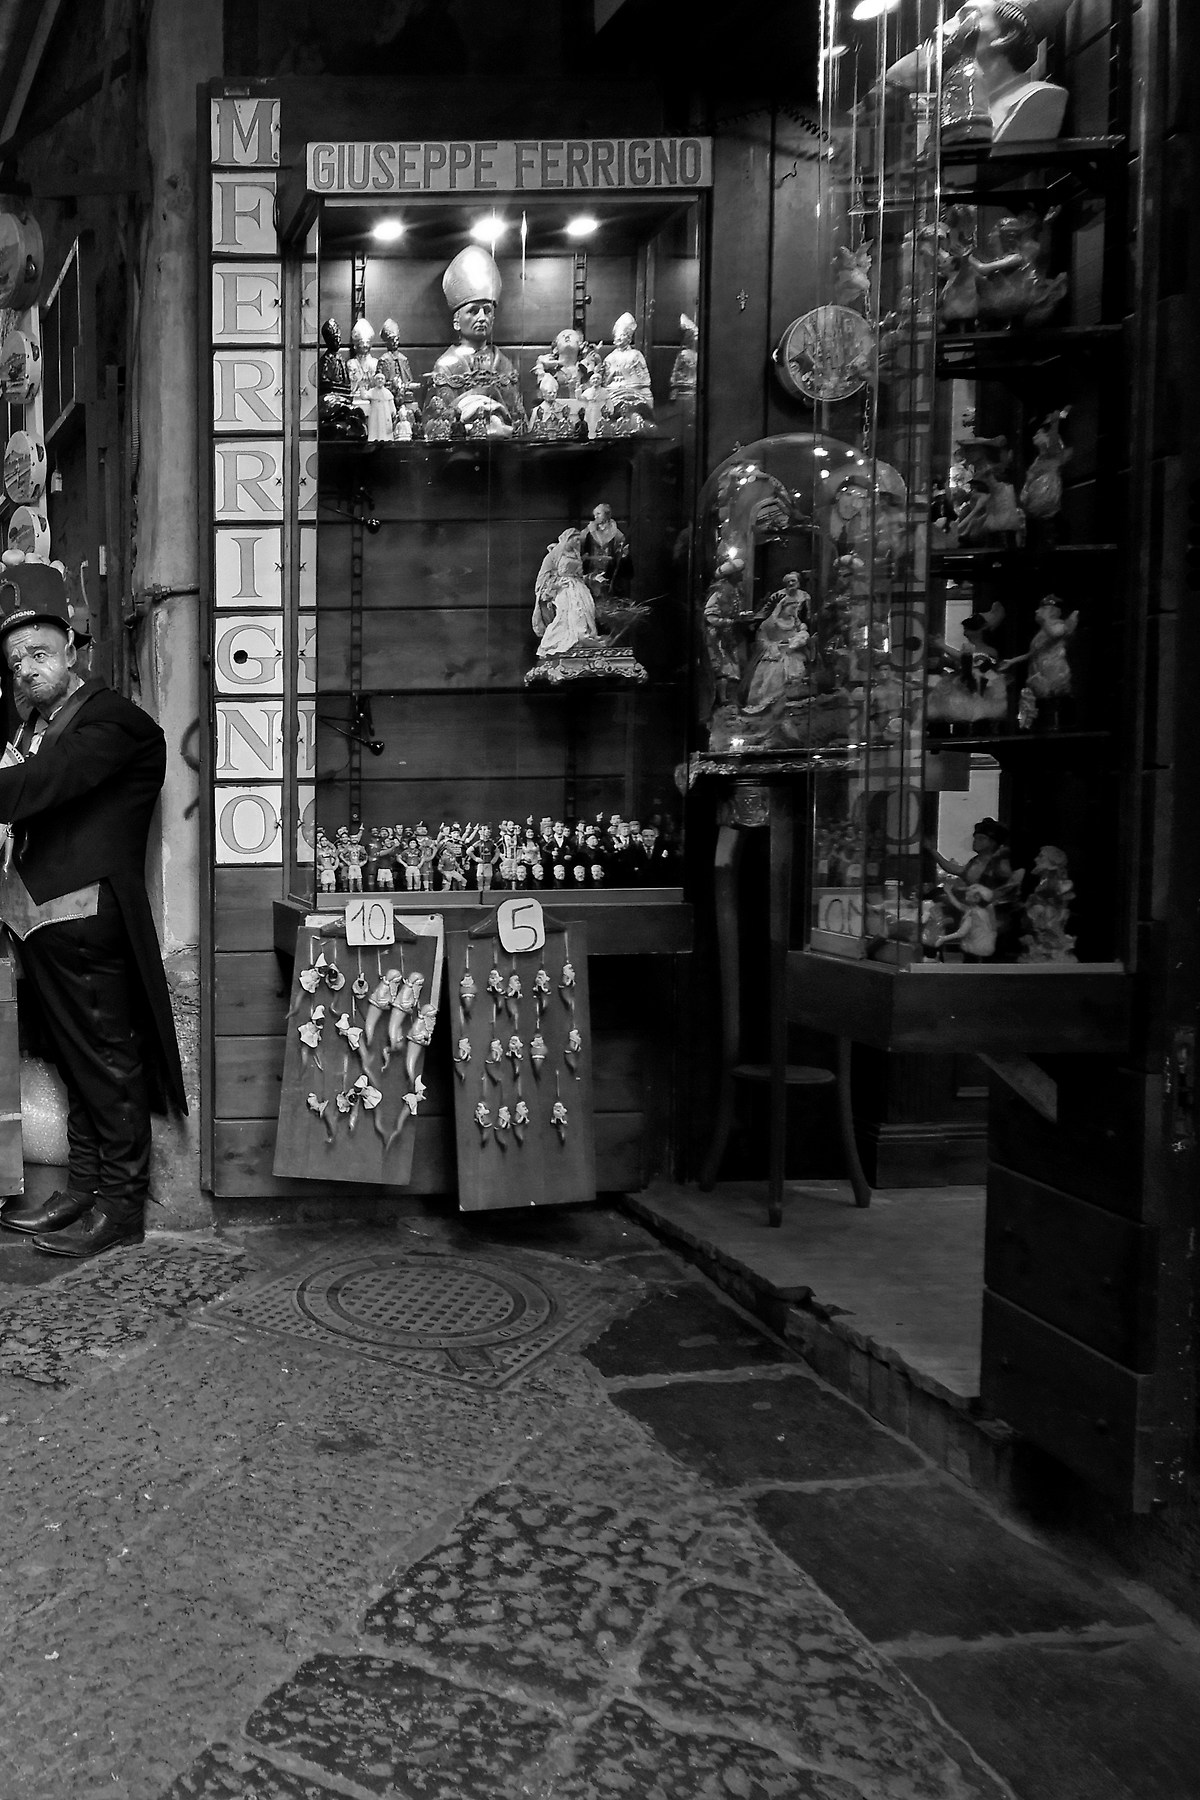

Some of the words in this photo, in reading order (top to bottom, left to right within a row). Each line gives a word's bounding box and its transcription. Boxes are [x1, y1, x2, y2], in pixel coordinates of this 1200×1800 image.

[312, 143, 498, 190] GIUSEPPE
[514, 139, 702, 188] FERRIGNO
[212, 180, 283, 855] FERRIGNO
[512, 903, 538, 951] 5
